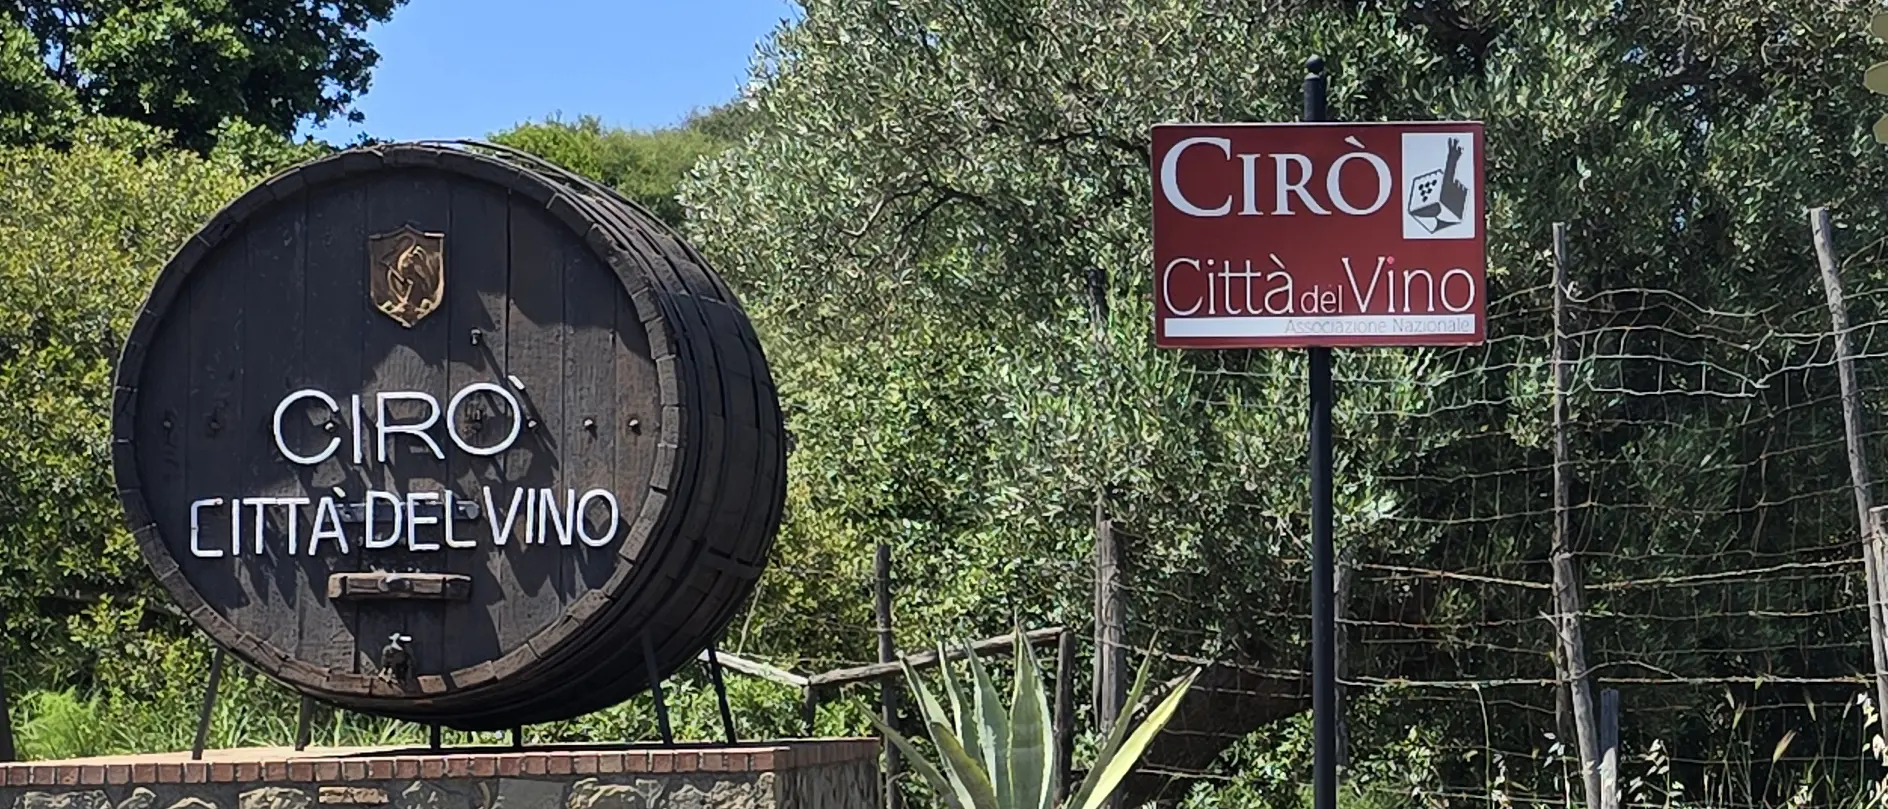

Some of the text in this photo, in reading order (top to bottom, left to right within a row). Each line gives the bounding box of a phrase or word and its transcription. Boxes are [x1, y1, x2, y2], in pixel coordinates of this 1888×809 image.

[1160, 135, 1392, 217] CIRÒ
[1162, 253, 1476, 316] Città del Vino
[1284, 317, 1470, 334] Associazione Nazionale
[273, 374, 525, 465] CIRÒ
[190, 486, 619, 557] CITTÀ DEL VINO
